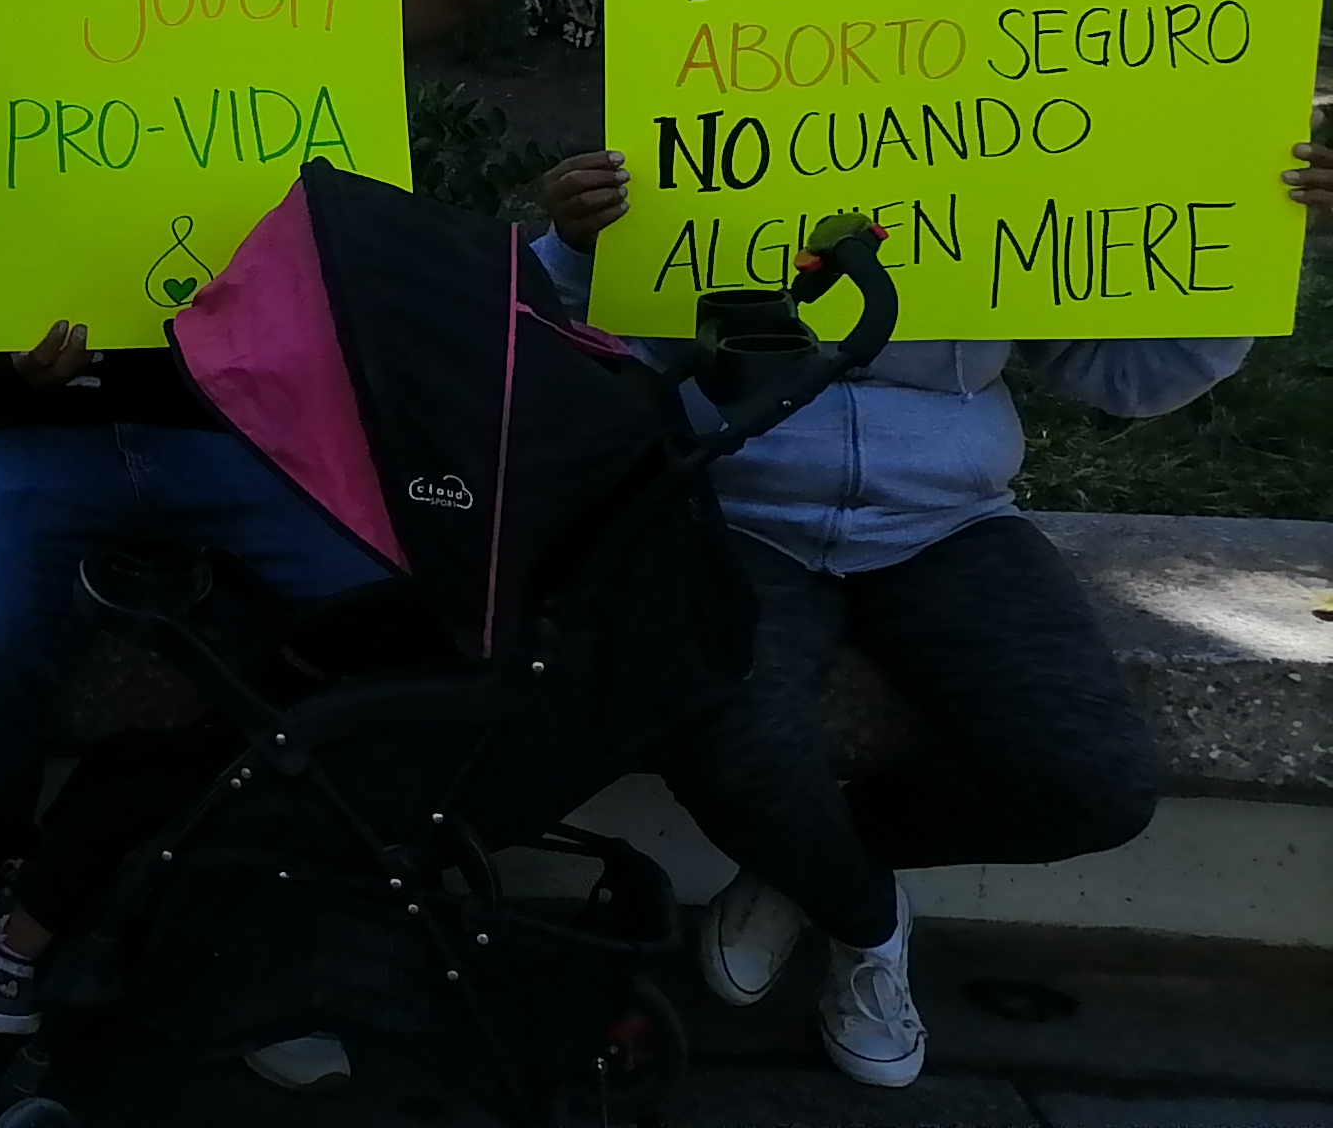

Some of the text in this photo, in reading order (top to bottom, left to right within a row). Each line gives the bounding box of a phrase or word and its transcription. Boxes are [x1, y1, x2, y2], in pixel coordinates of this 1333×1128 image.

[675, 0, 1250, 95] ABORTO SEGURO
[7, 86, 358, 189] PRO-VIDA
[653, 97, 1092, 194] NO CUANDO
[653, 193, 1236, 310] ALGEN MUERE
[416, 483, 463, 500] cloud
